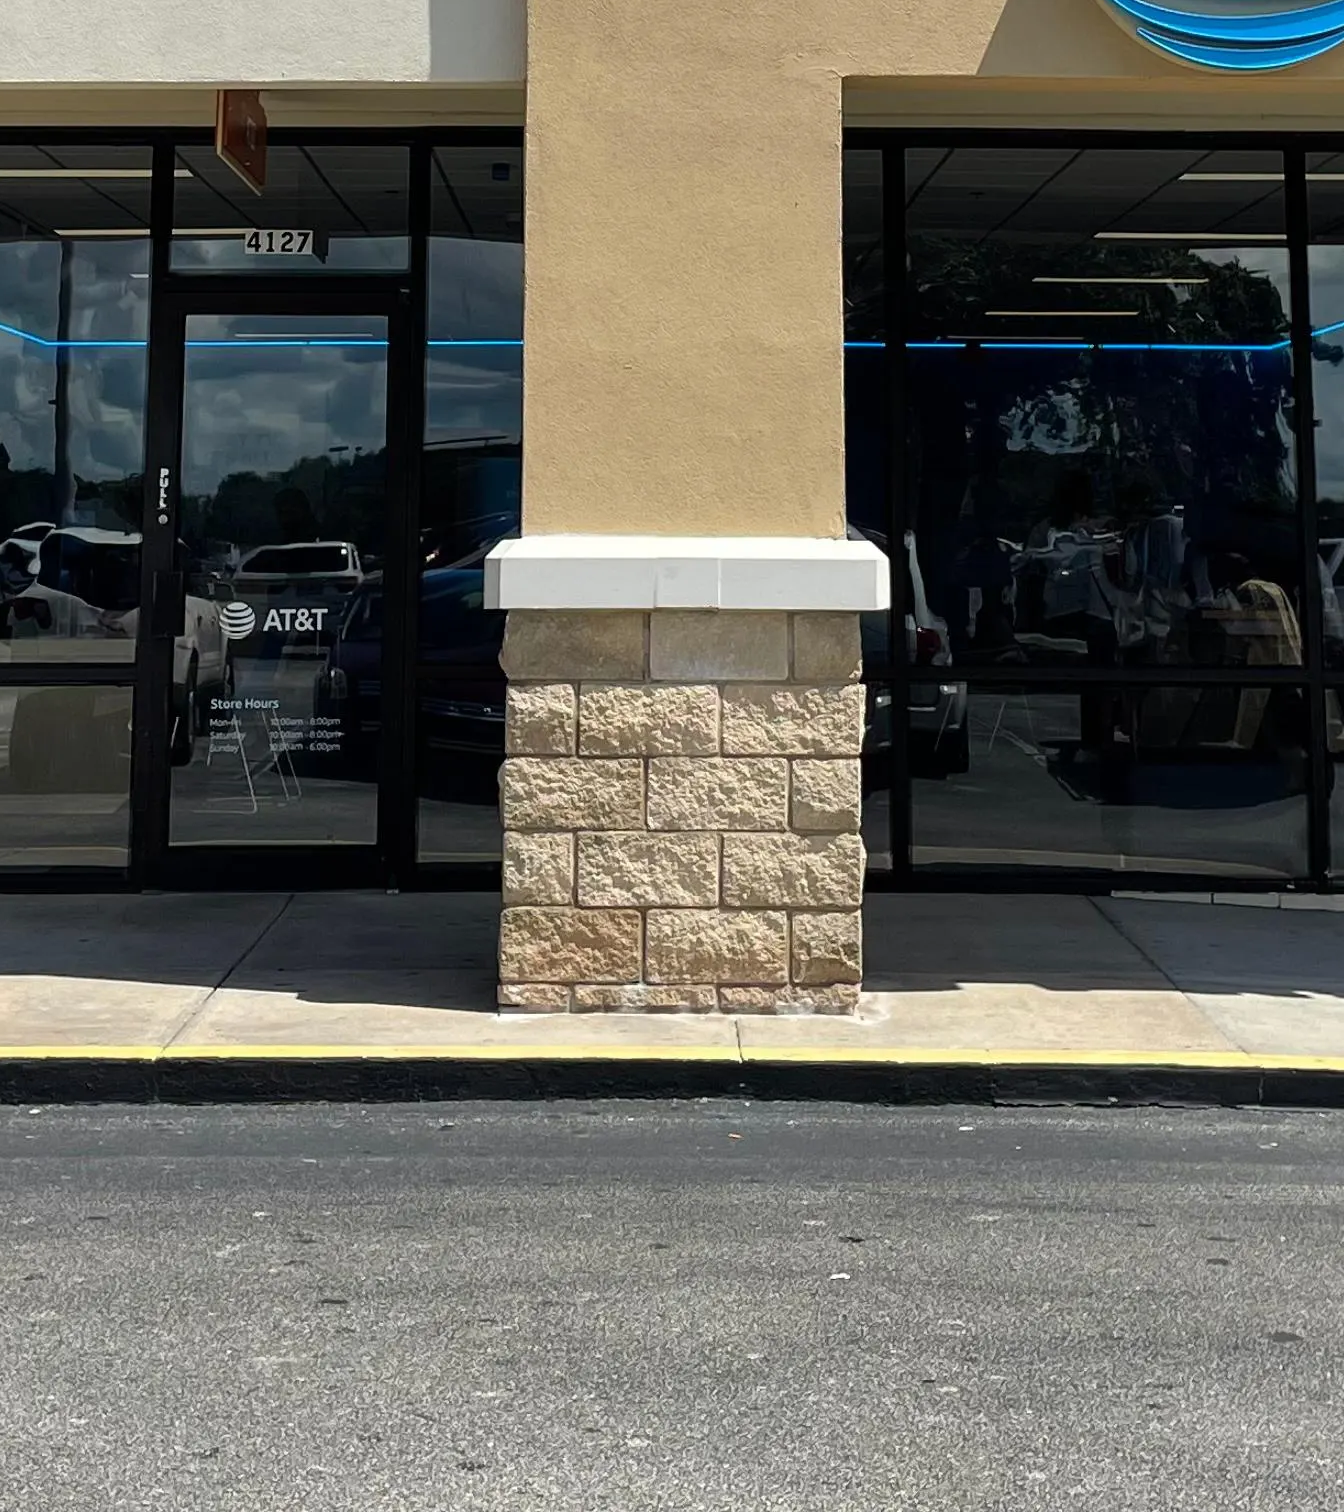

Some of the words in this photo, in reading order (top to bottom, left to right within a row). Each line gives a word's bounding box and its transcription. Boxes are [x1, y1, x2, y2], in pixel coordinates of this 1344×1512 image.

[246, 231, 312, 253] 4127
[159, 467, 170, 508] PULL
[262, 608, 329, 632] AT&T
[210, 698, 243, 709] Store
[244, 698, 280, 709] Hours
